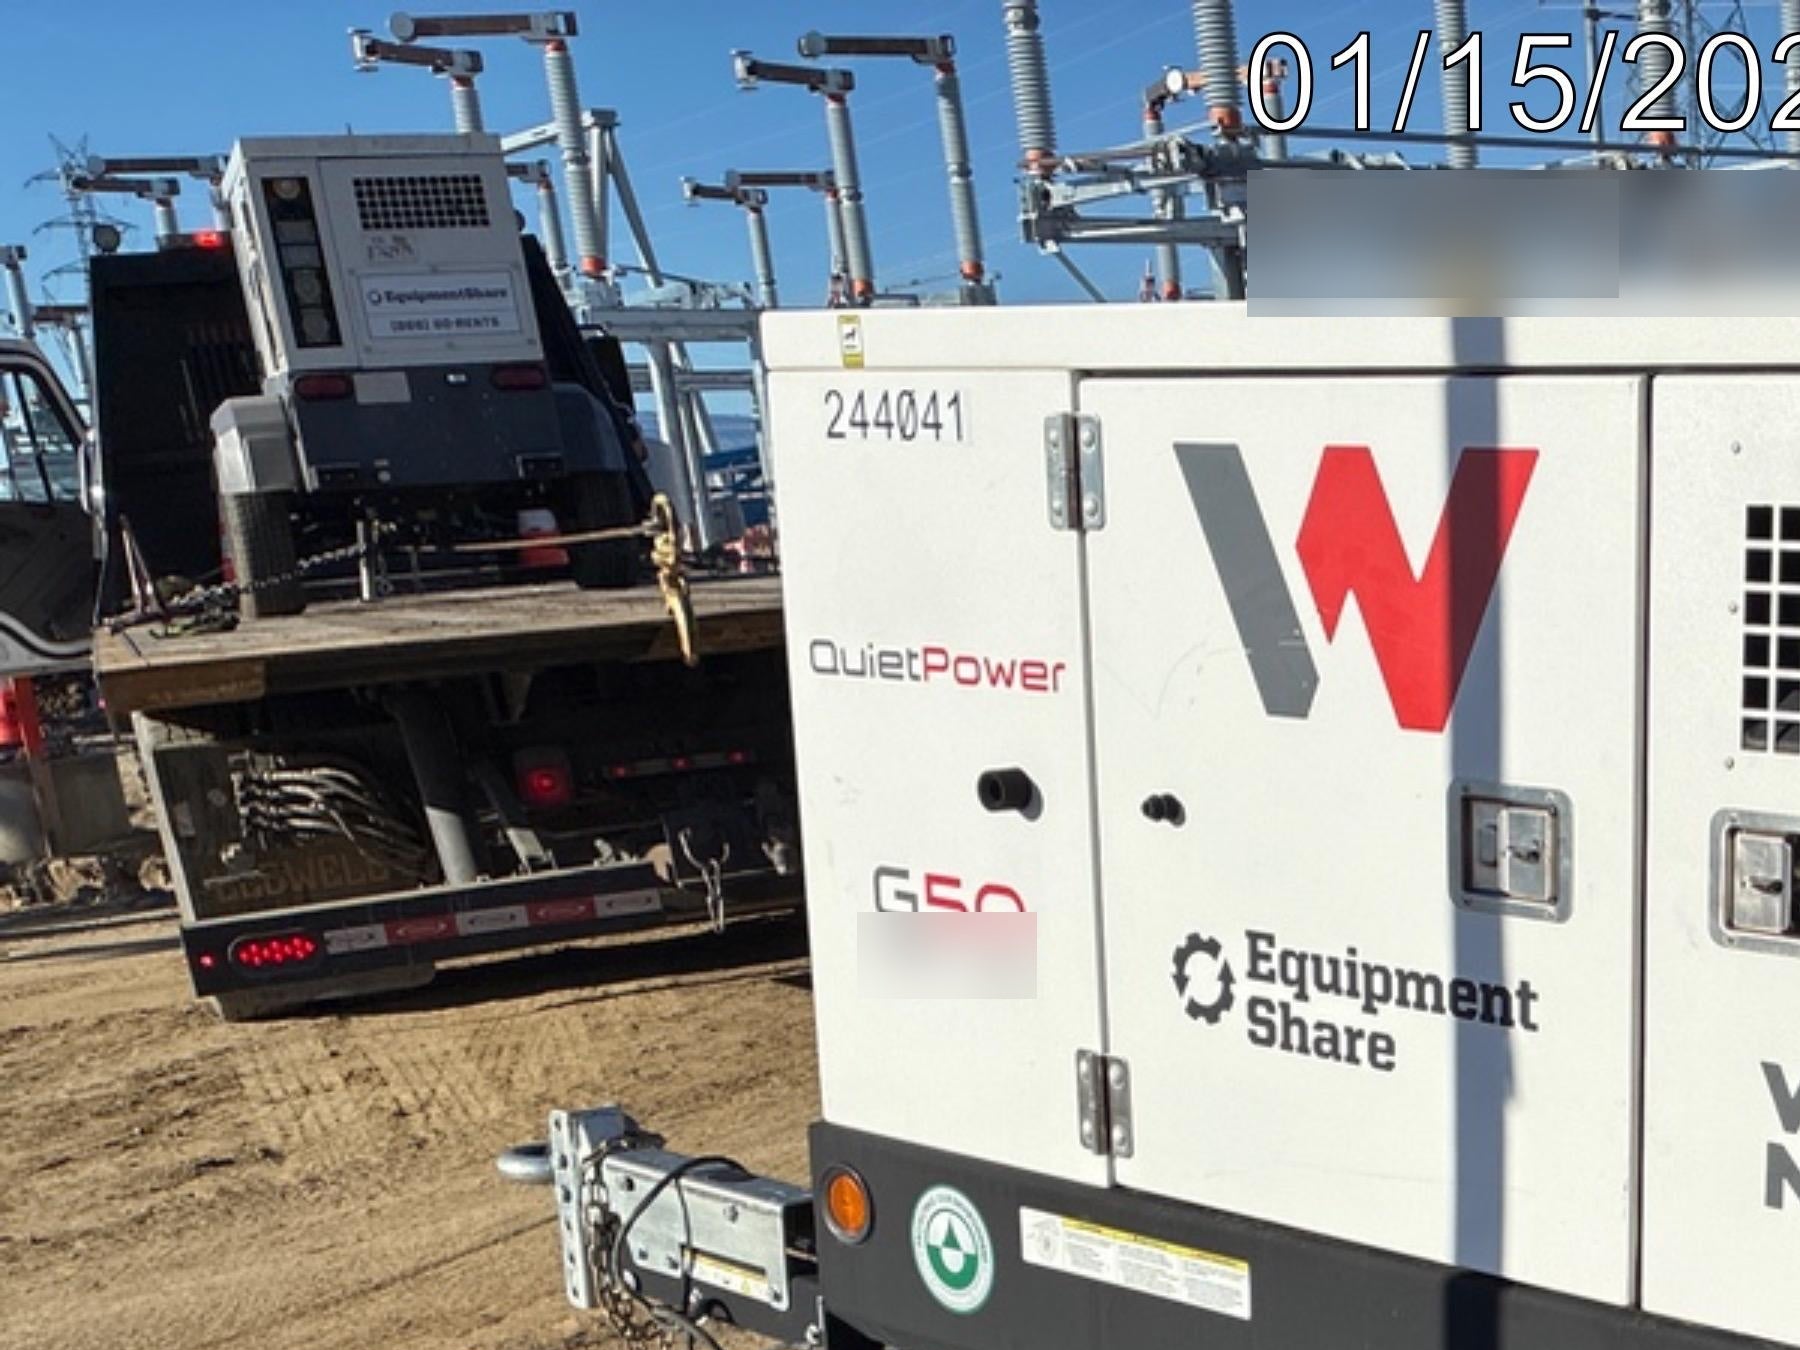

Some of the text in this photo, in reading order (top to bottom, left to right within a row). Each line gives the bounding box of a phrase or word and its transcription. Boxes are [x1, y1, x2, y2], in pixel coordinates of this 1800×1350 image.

[824, 388, 963, 442] 244041
[809, 639, 1066, 693] QuietPower
[1246, 930, 1539, 1032] Equipment
[1247, 995, 1397, 1072] Share
